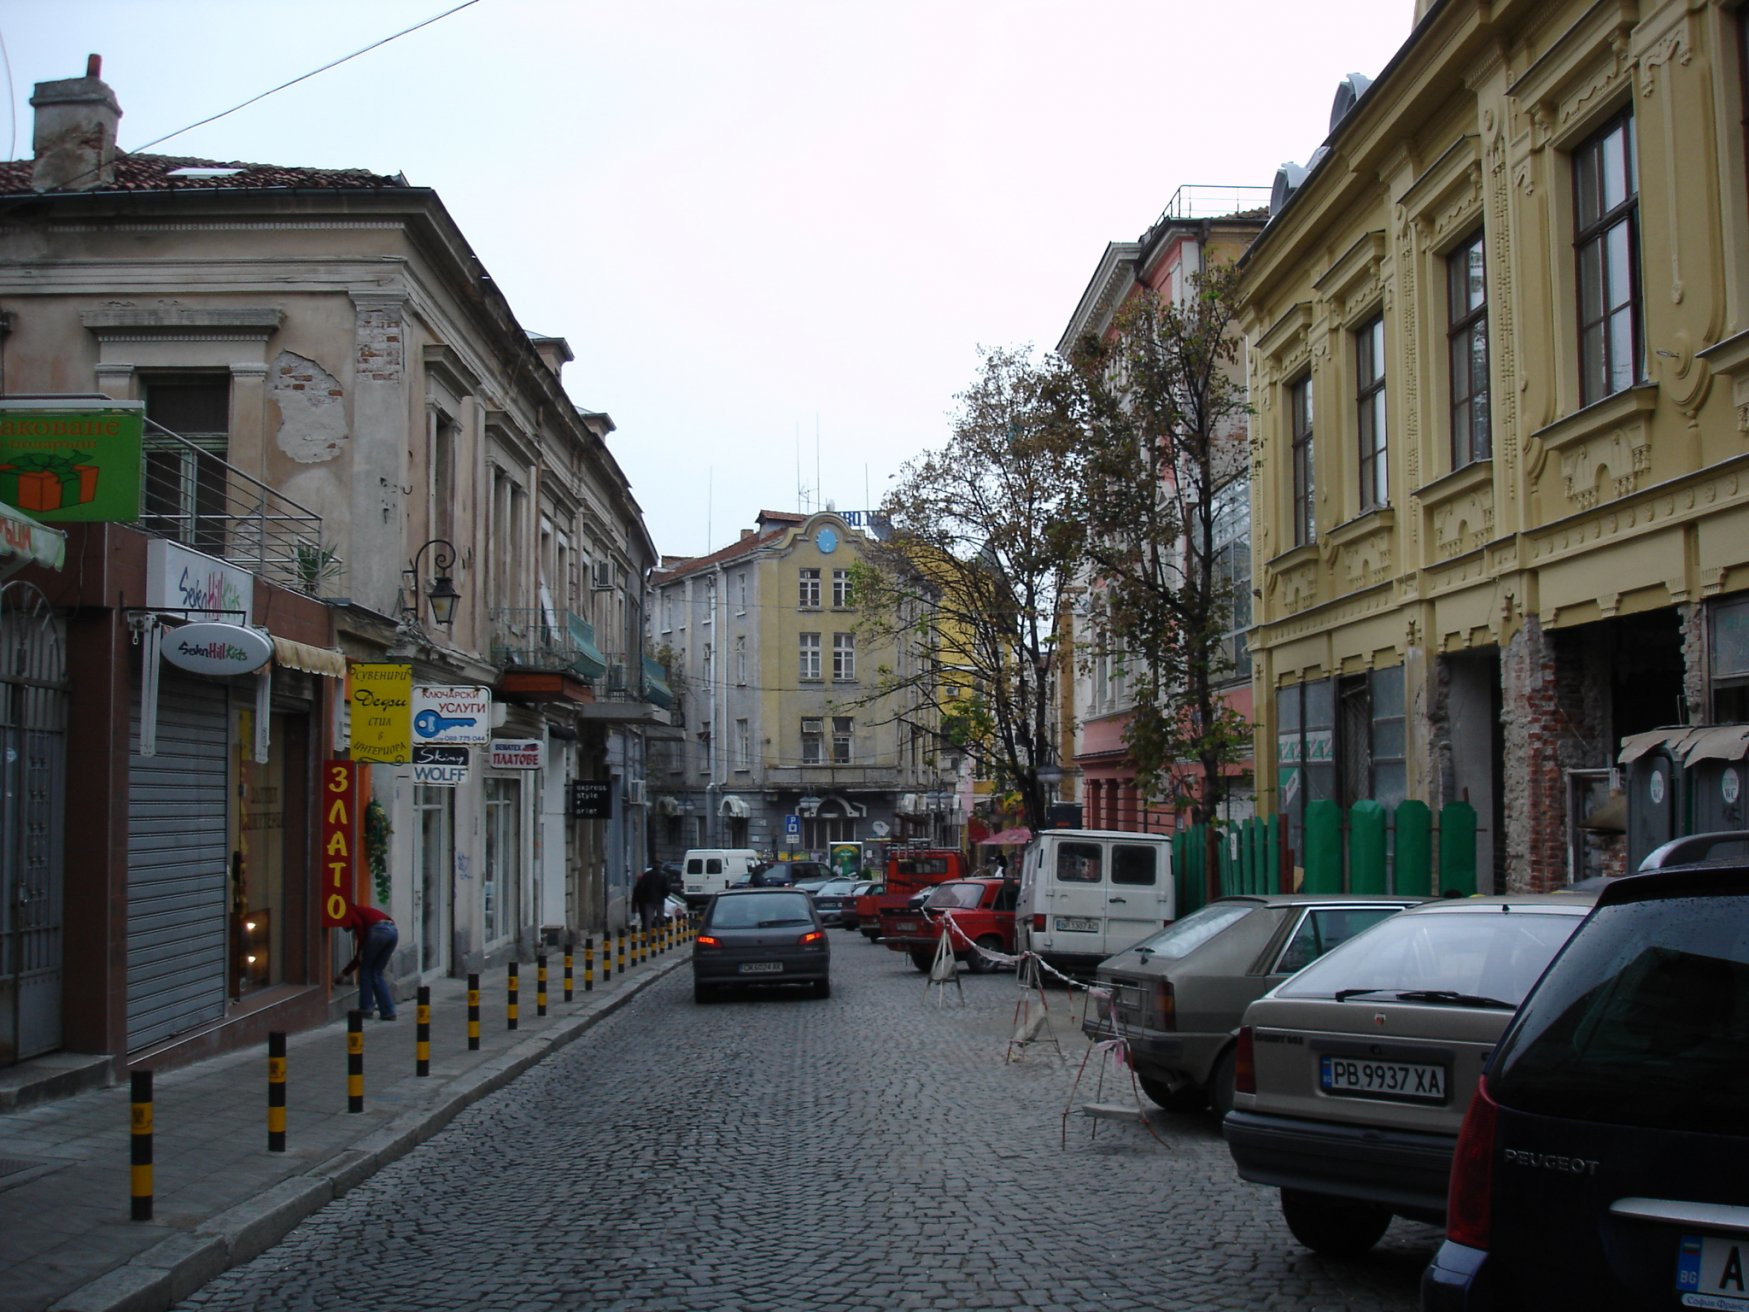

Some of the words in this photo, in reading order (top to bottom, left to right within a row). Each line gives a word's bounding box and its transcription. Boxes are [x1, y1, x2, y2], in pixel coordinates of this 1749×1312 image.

[422, 690, 479, 699] КЛЮЧАРСКИ
[438, 703, 486, 713] УСЛУГИ
[493, 753, 538, 765] ПЛАТОВЕ
[414, 767, 466, 781] WOLFF
[327, 766, 348, 920] ЗЛАТО
[1334, 1062, 1359, 1086] PB
[1363, 1064, 1410, 1091] 9937
[1414, 1068, 1441, 1094] XA
[1504, 1148, 1600, 1176] PEUGEOT
[1680, 1270, 1697, 1285] BG
